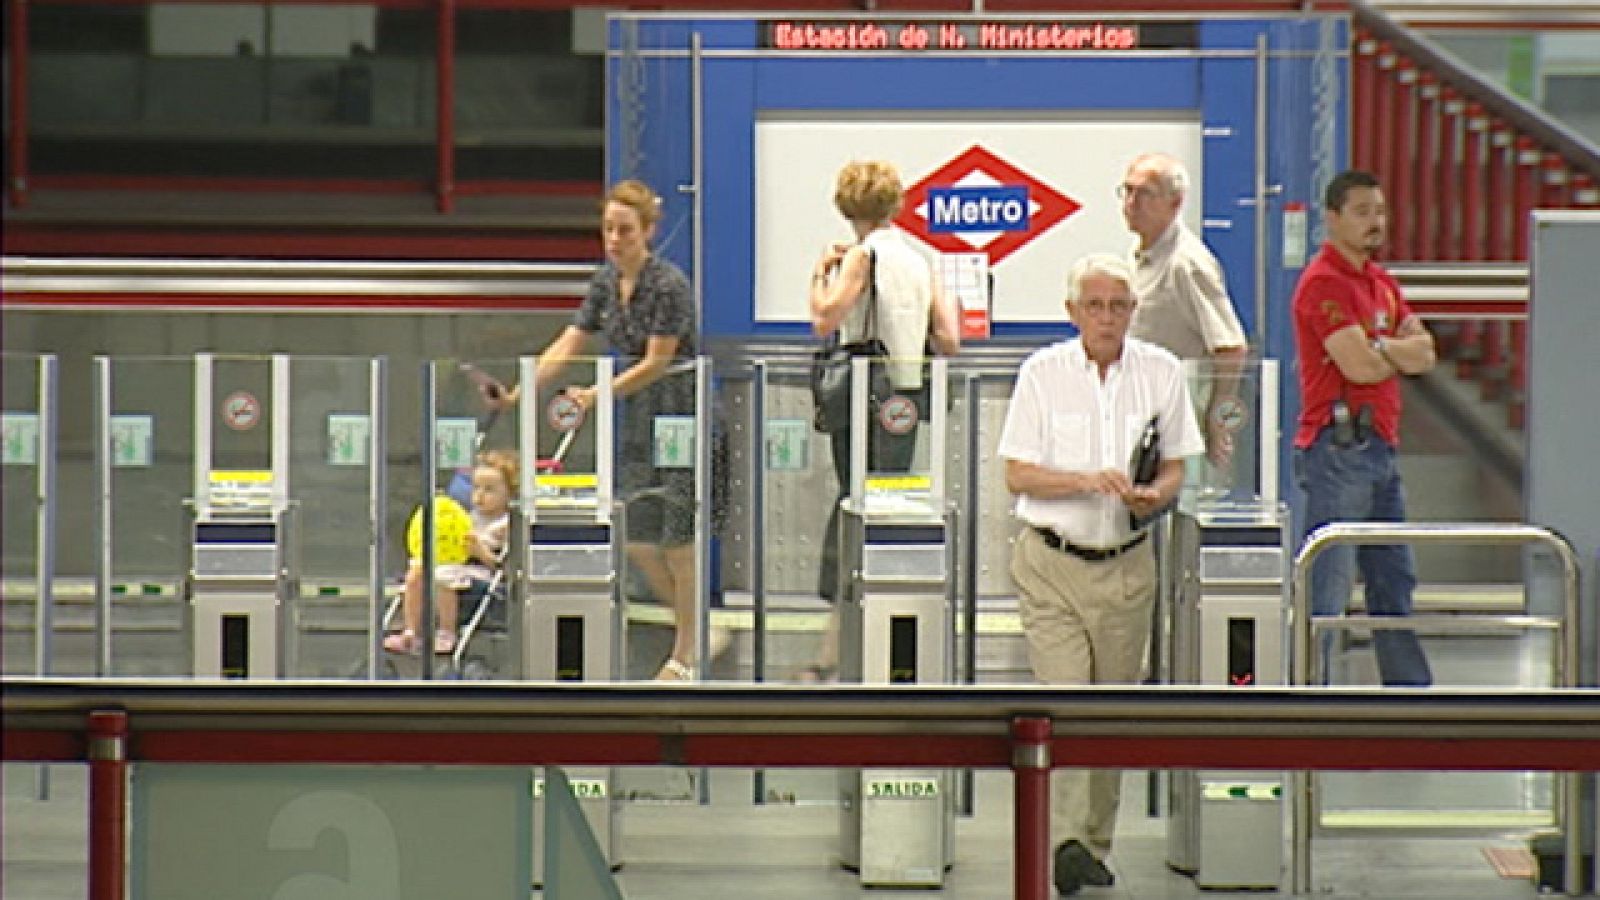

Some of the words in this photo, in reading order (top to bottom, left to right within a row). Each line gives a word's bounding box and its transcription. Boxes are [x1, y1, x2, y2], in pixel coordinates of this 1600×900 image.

[899, 23, 929, 48] de
[981, 23, 1135, 48] Ministerios
[933, 195, 1024, 225] Metro
[871, 782, 936, 798] SALIDA
